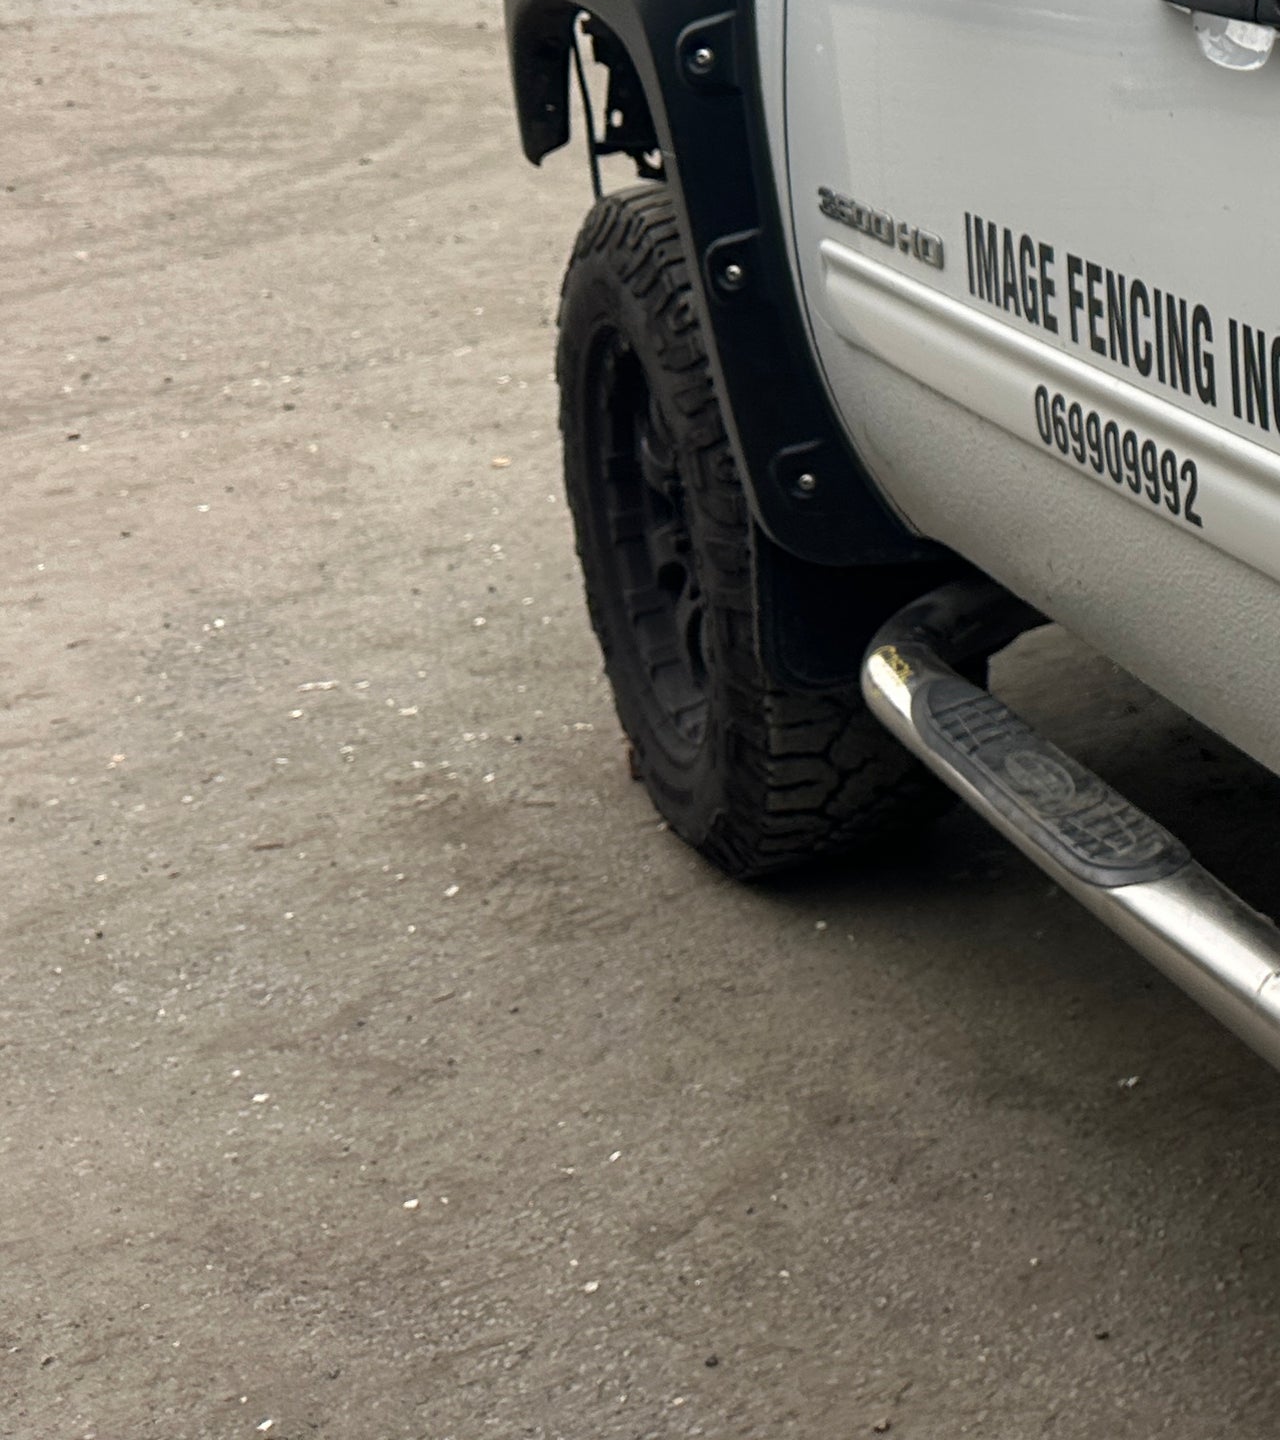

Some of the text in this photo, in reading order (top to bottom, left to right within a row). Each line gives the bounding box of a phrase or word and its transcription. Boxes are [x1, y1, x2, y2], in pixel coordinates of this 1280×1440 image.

[964, 211, 1058, 335] IMAGE
[1067, 253, 1217, 408] FENCING
[1034, 385, 1204, 528] 069909992
